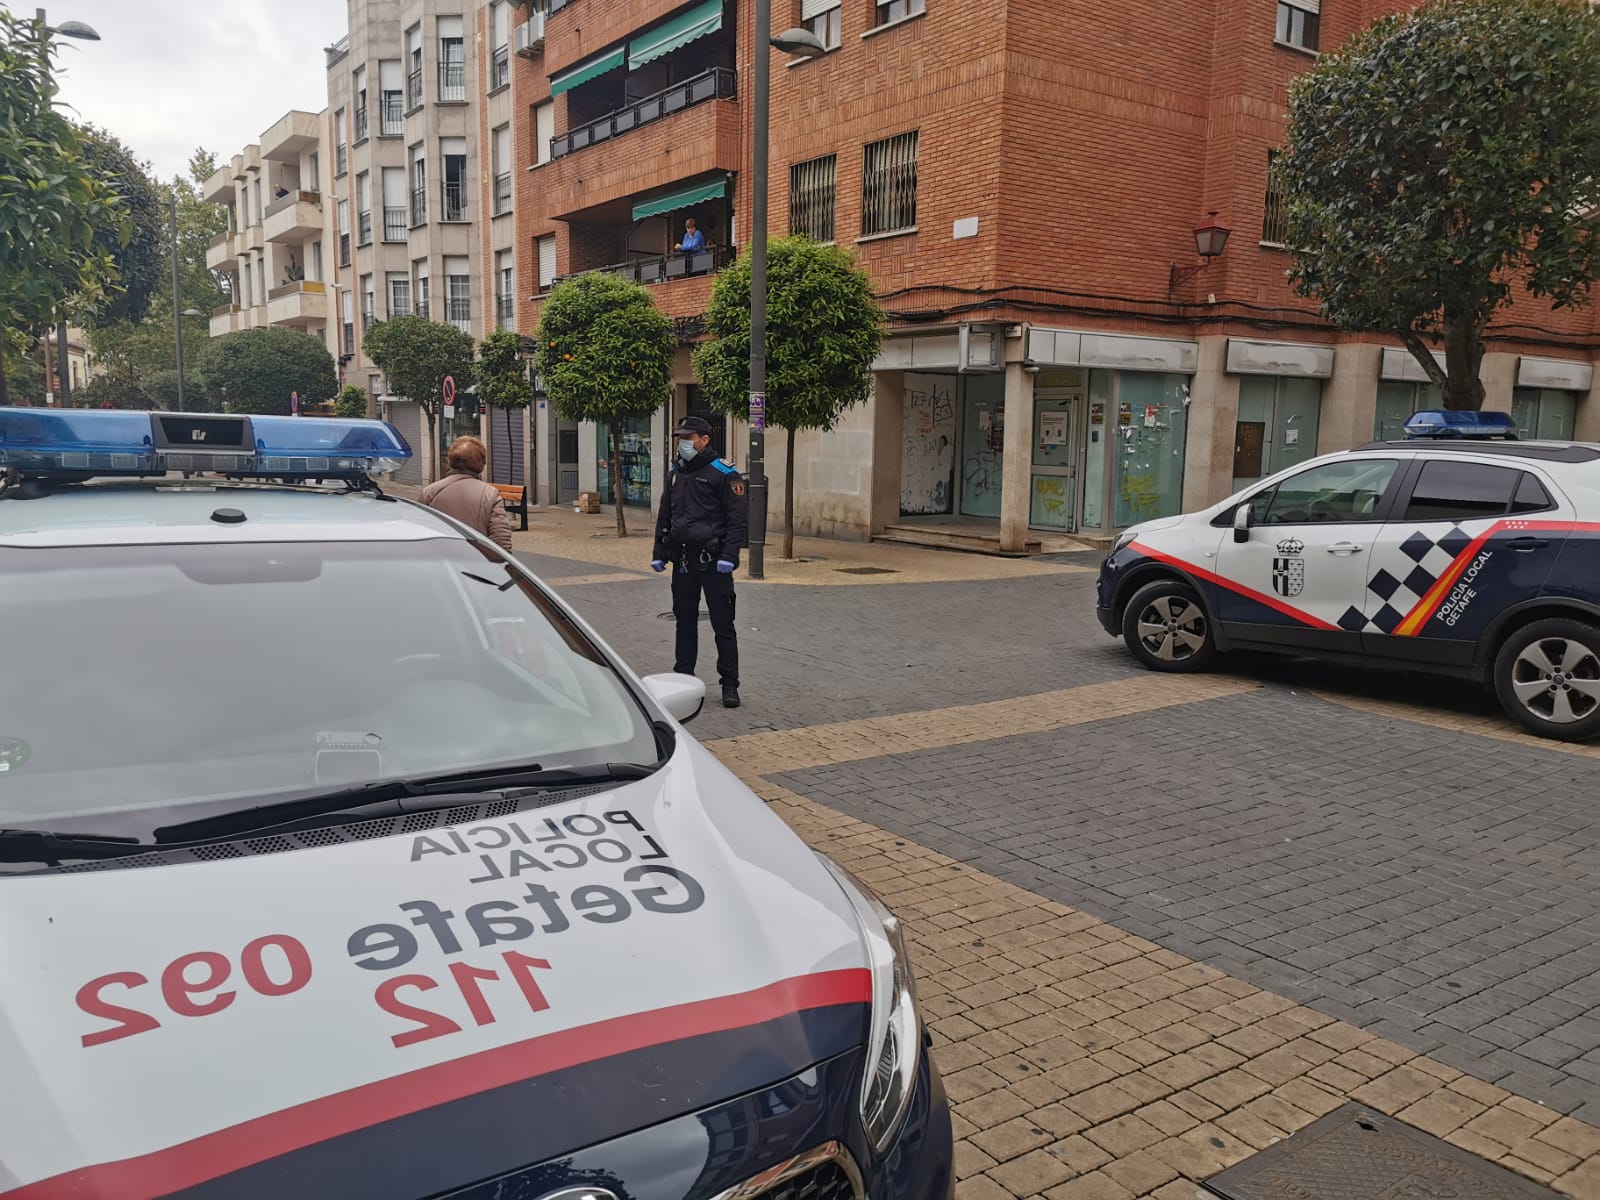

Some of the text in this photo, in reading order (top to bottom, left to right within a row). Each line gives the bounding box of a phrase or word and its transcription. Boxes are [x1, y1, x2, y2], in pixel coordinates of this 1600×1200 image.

[1436, 551, 1493, 621] POLICÍA LOCAL
[1446, 588, 1477, 626] GETAFE
